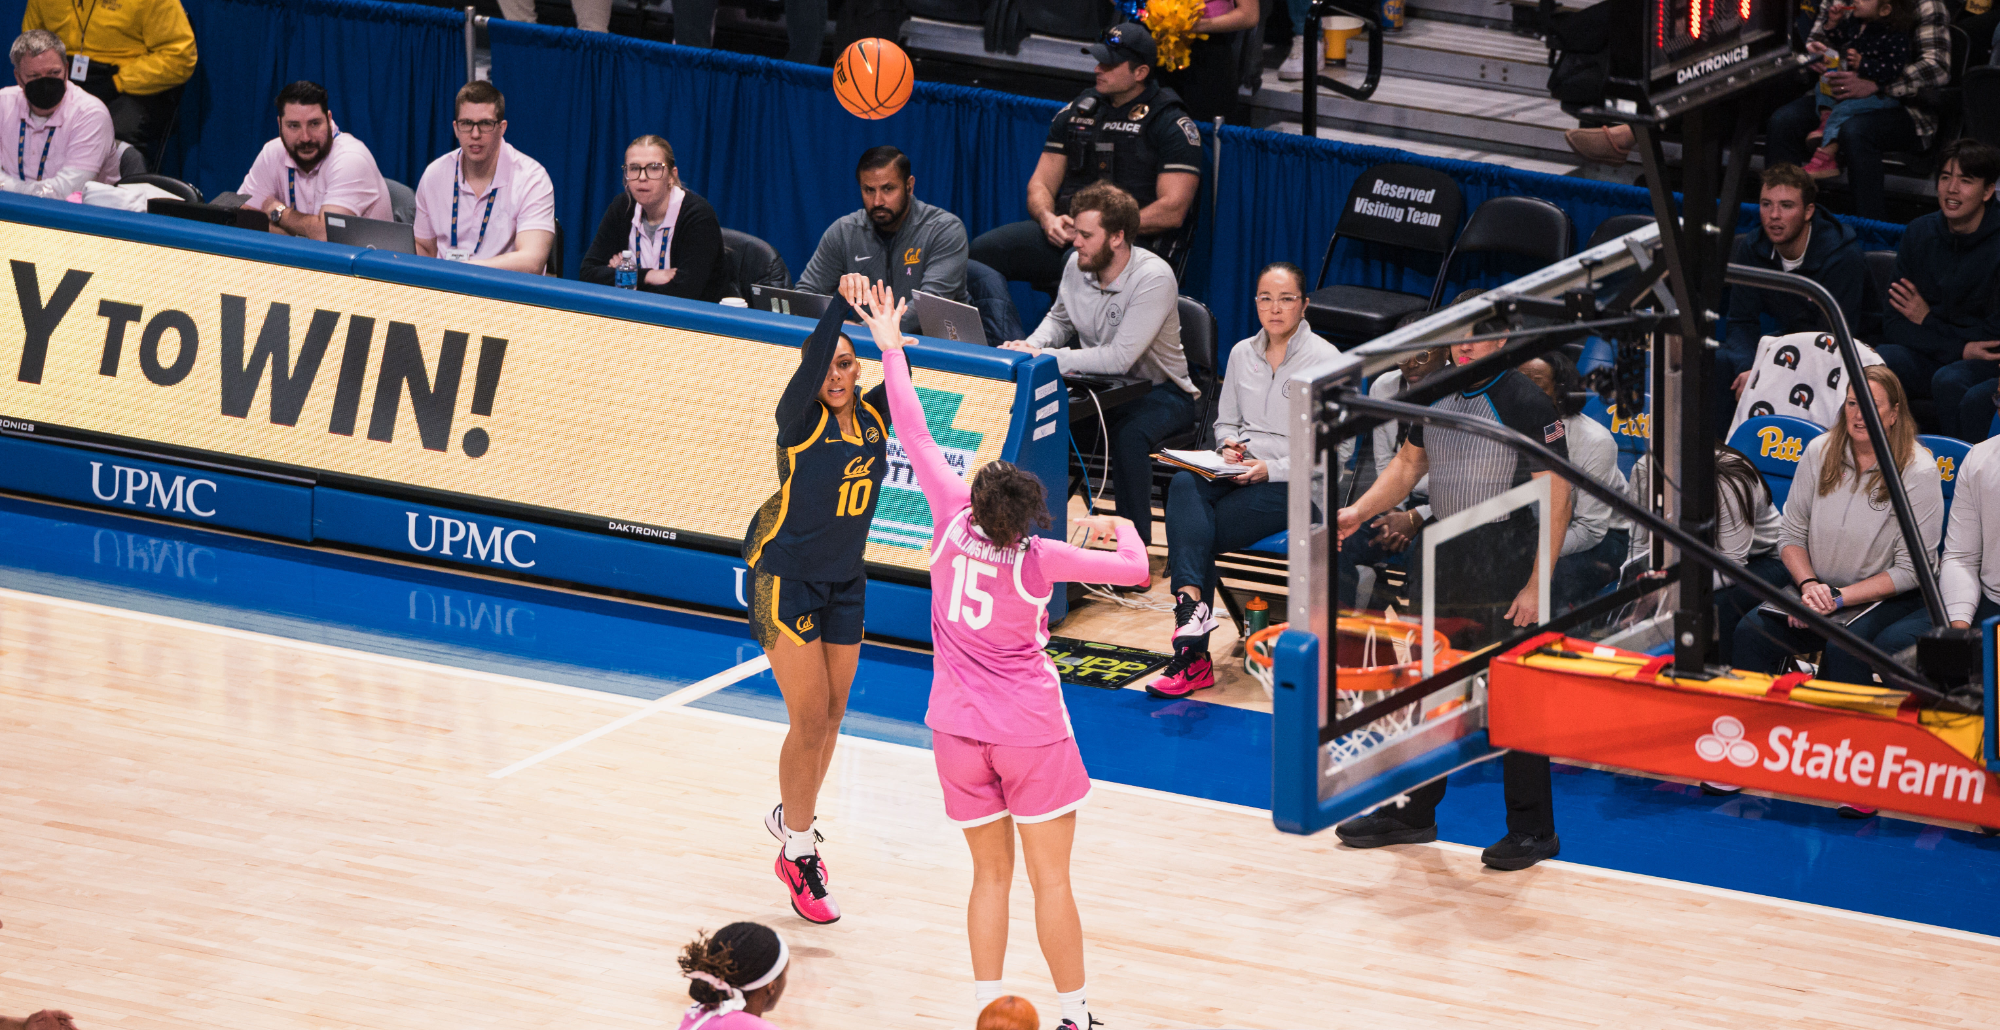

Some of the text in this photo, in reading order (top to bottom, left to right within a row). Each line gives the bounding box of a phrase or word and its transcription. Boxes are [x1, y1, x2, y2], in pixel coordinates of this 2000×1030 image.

[1676, 44, 1749, 85] DAKTRONICS
[1102, 121, 1142, 133] POLICE
[1372, 178, 1436, 204] Reserved
[1354, 197, 1441, 227] Visiting Team
[904, 247, 921, 266] Cal
[9, 258, 95, 385] Y
[220, 292, 509, 459] WIN!
[1756, 426, 1803, 463] Pitt
[842, 456, 875, 479] Cal
[90, 461, 217, 517] UPMC
[836, 478, 873, 517] 10
[405, 511, 536, 568] UPMC
[608, 521, 677, 540] DAKTRONICS
[947, 553, 998, 631] 15
[796, 613, 815, 635] Cal
